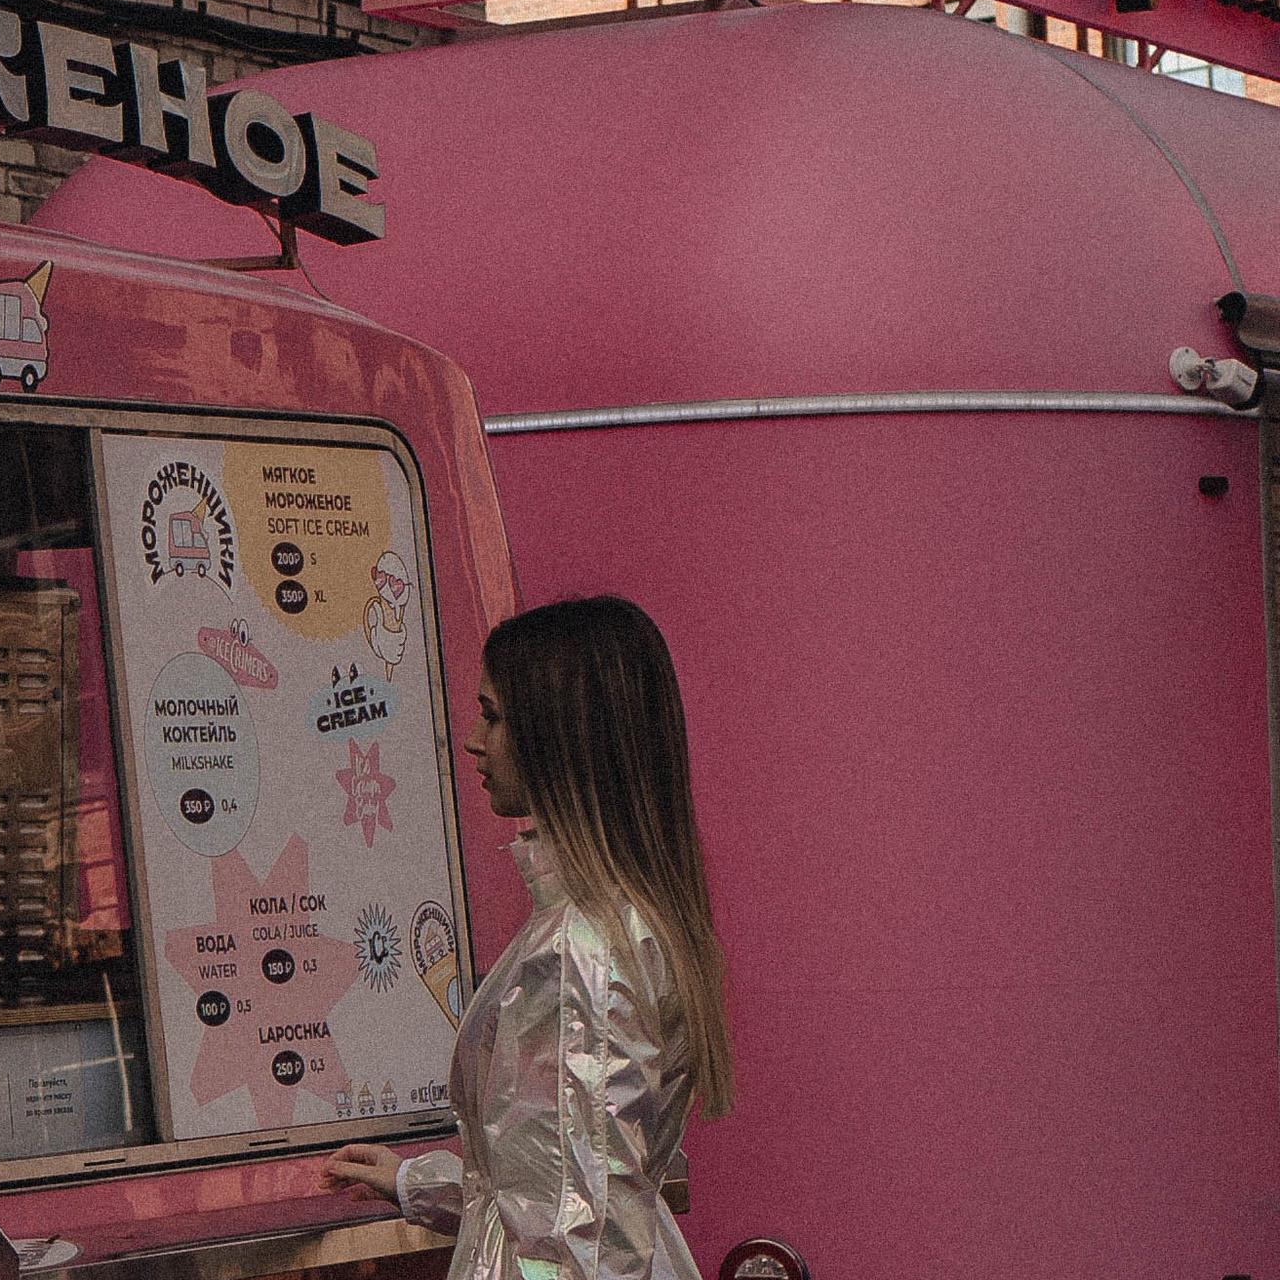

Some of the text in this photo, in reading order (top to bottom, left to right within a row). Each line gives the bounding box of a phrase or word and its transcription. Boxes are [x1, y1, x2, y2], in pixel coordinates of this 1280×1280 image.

[262, 466, 316, 484] МЯГКОЕ
[265, 492, 352, 511] МОРОЖЕНОЕ
[141, 461, 234, 590] МОРОЖЕНЩИКИ
[268, 517, 370, 537] SOFT ICE CREAM
[310, 552, 317, 565] S
[314, 589, 327, 602] XL
[155, 694, 239, 717] МОЛОЧНЫЙ
[333, 686, 368, 709] ICE
[317, 700, 388, 733] CREAM
[163, 721, 237, 743] КОКТЕЙЛЬ
[172, 755, 234, 770] MILKSHAKE
[250, 897, 288, 915] КОЛА
[300, 894, 327, 912] СОК
[252, 926, 282, 941] COLA
[290, 923, 319, 938] JUICE
[196, 935, 237, 955] ВОДА
[199, 963, 237, 980] WATER
[258, 1021, 331, 1044] LAPOCHKA
